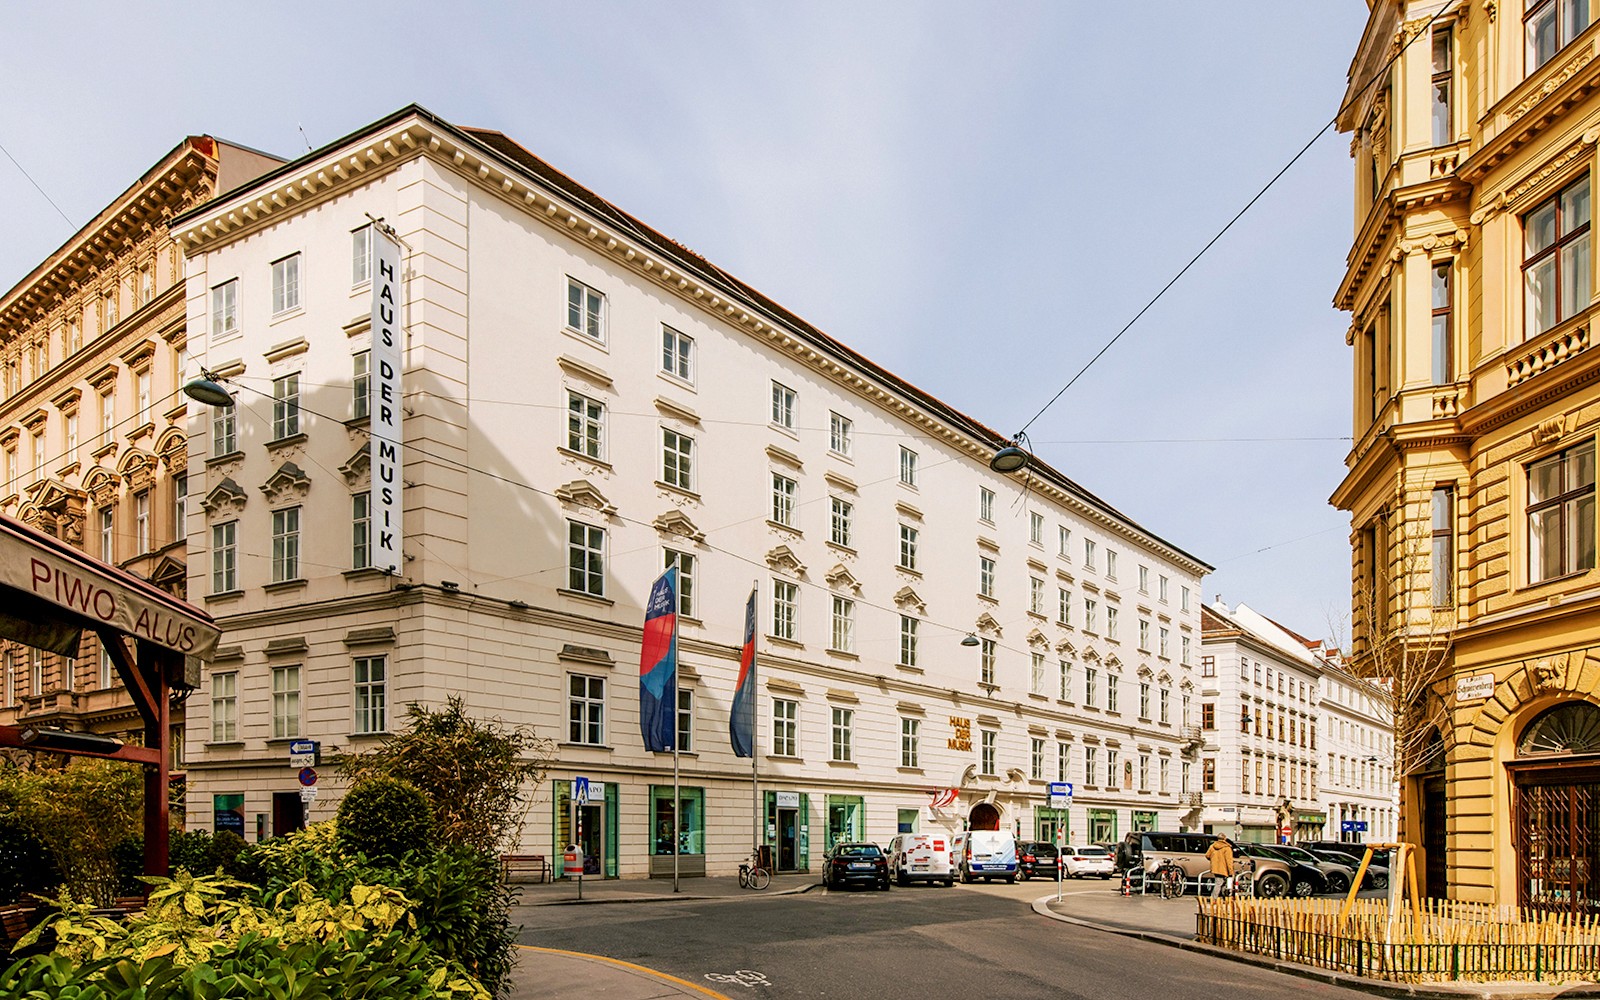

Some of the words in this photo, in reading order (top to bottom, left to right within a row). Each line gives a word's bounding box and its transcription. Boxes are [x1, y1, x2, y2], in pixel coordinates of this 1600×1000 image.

[379, 258, 394, 348] HAUS
[380, 359, 394, 427] DER
[379, 440, 396, 551] MUSIK
[30, 557, 116, 621] PIWO
[134, 608, 196, 652] ALUS
[947, 738, 972, 752] MUSIK
[949, 715, 970, 729] HAUS
[955, 728, 971, 741] DER
